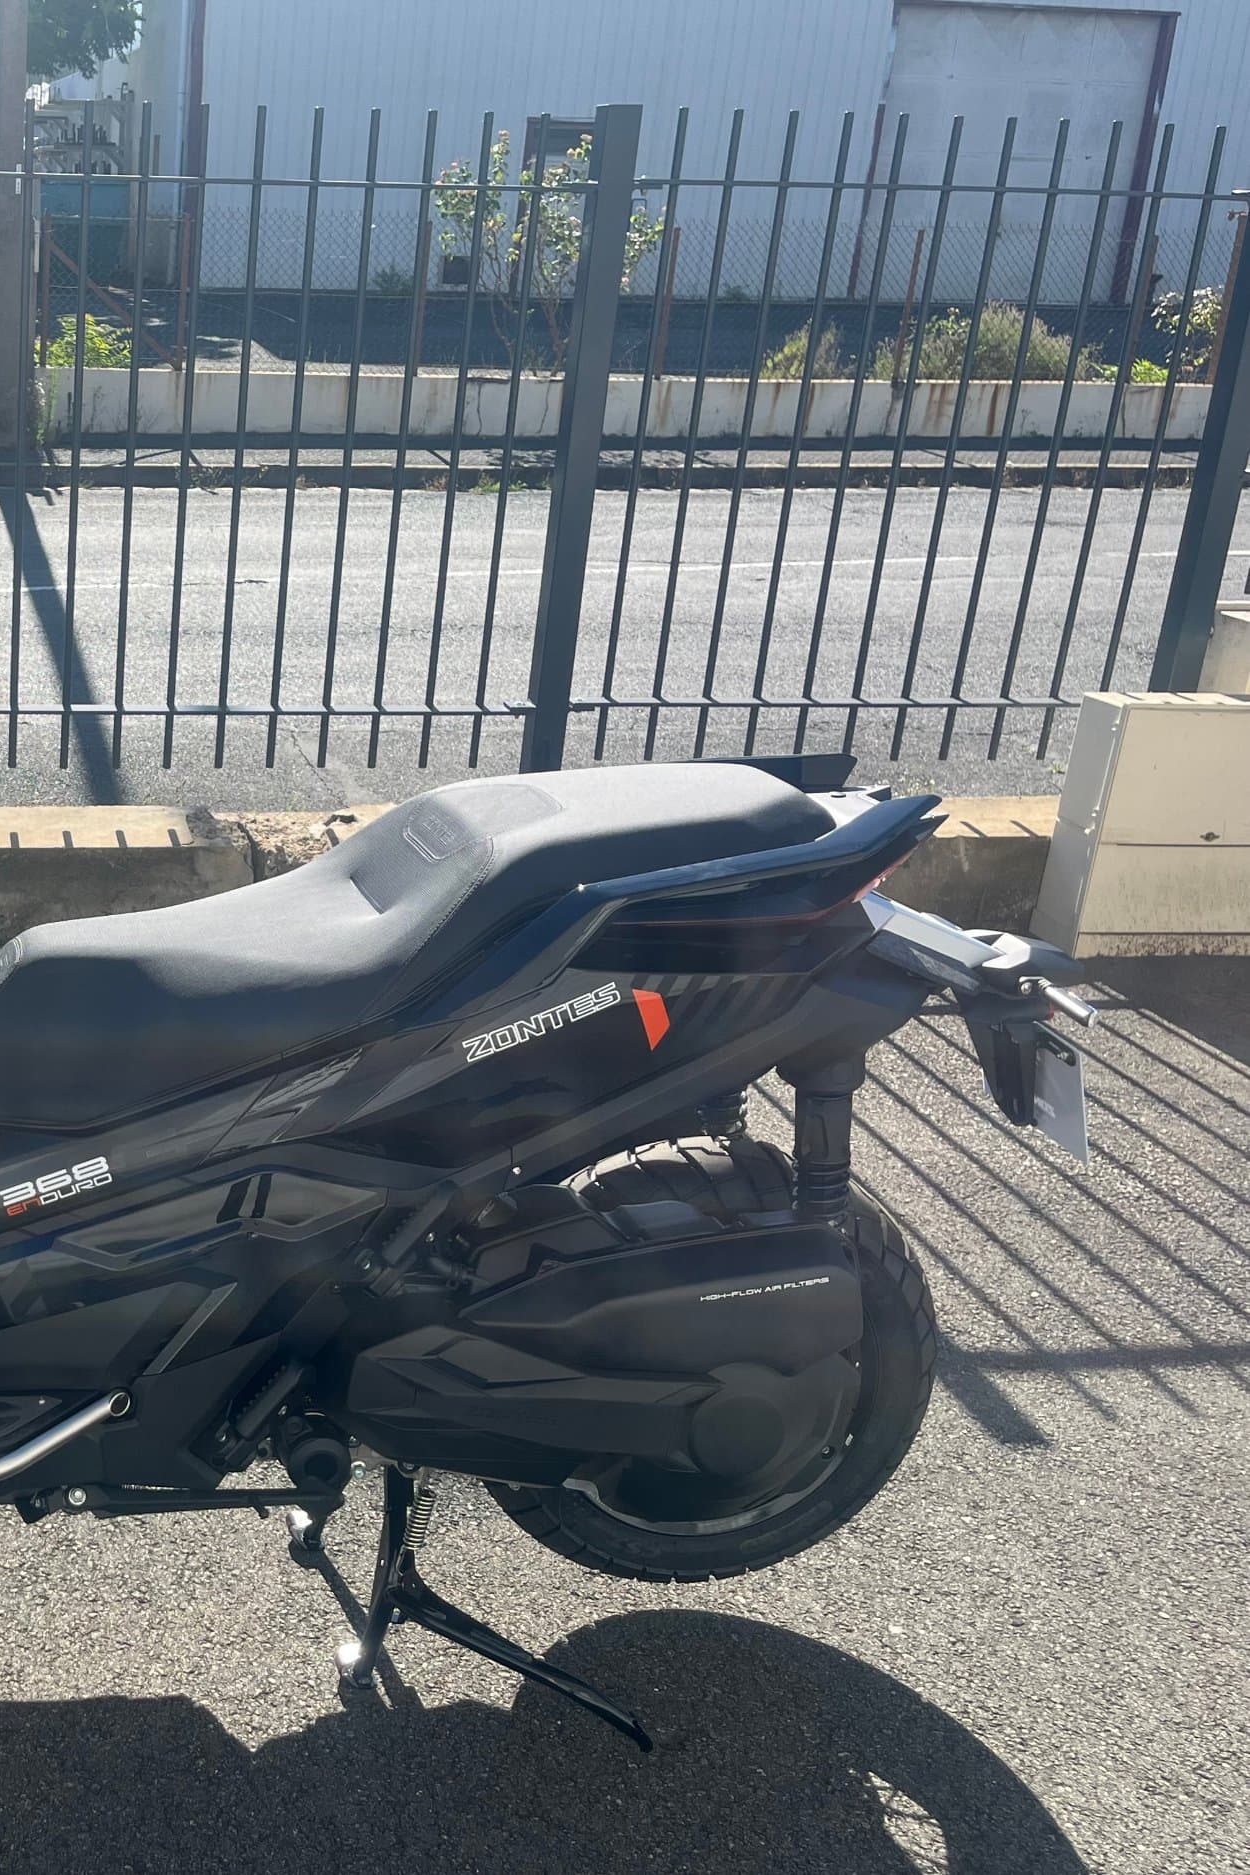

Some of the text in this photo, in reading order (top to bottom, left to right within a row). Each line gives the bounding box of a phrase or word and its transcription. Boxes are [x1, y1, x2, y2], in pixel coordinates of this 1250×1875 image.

[462, 981, 621, 1062] ZONTES
[0, 1156, 109, 1207] 368
[764, 1284, 782, 1293] AIR
[783, 1276, 830, 1290] FILTERS
